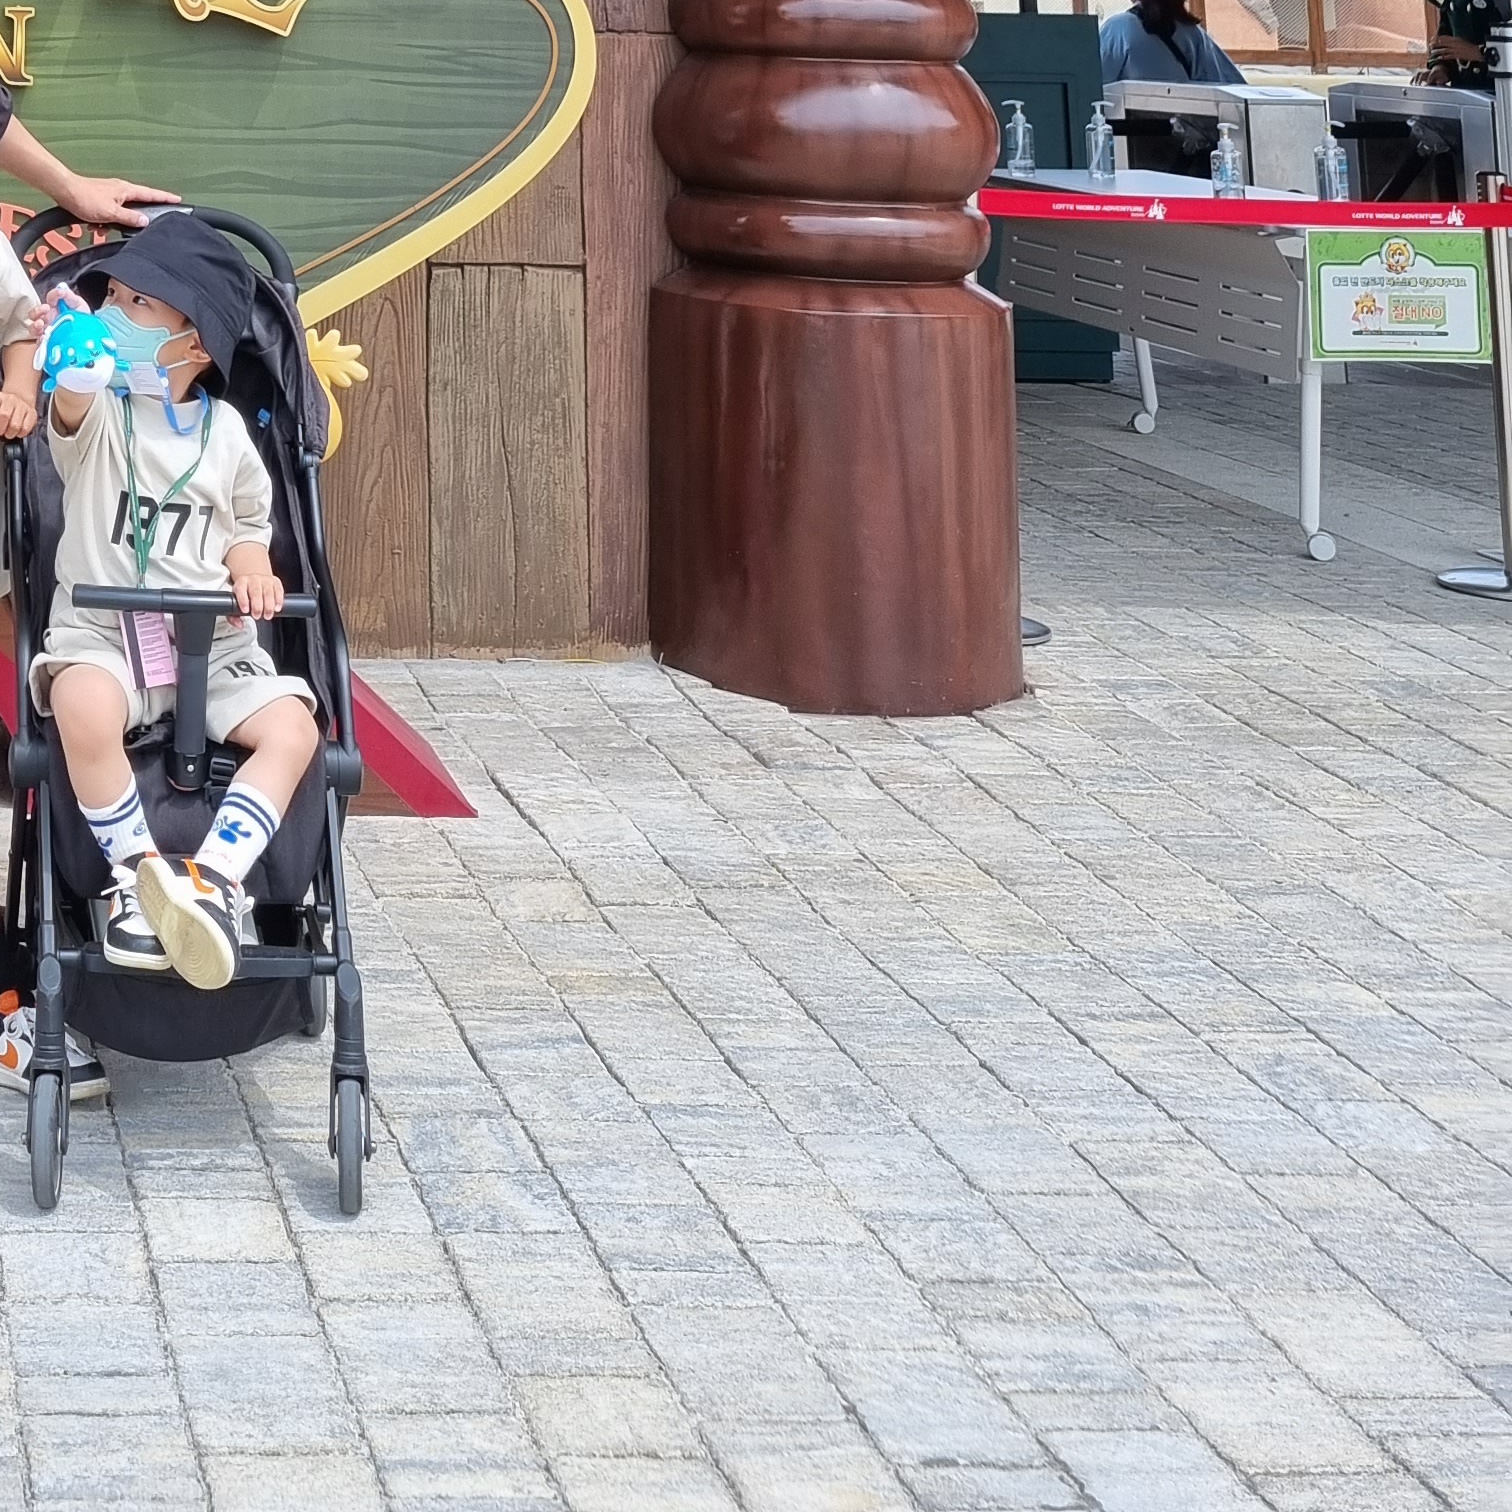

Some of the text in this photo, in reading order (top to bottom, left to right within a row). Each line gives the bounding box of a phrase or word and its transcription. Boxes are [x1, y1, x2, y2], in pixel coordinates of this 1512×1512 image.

[1052, 203, 1074, 211] LOTTE
[1102, 205, 1144, 213] ADVENTURE
[1375, 212, 1400, 220] WORLD
[1392, 304, 1443, 321] 절대 NO
